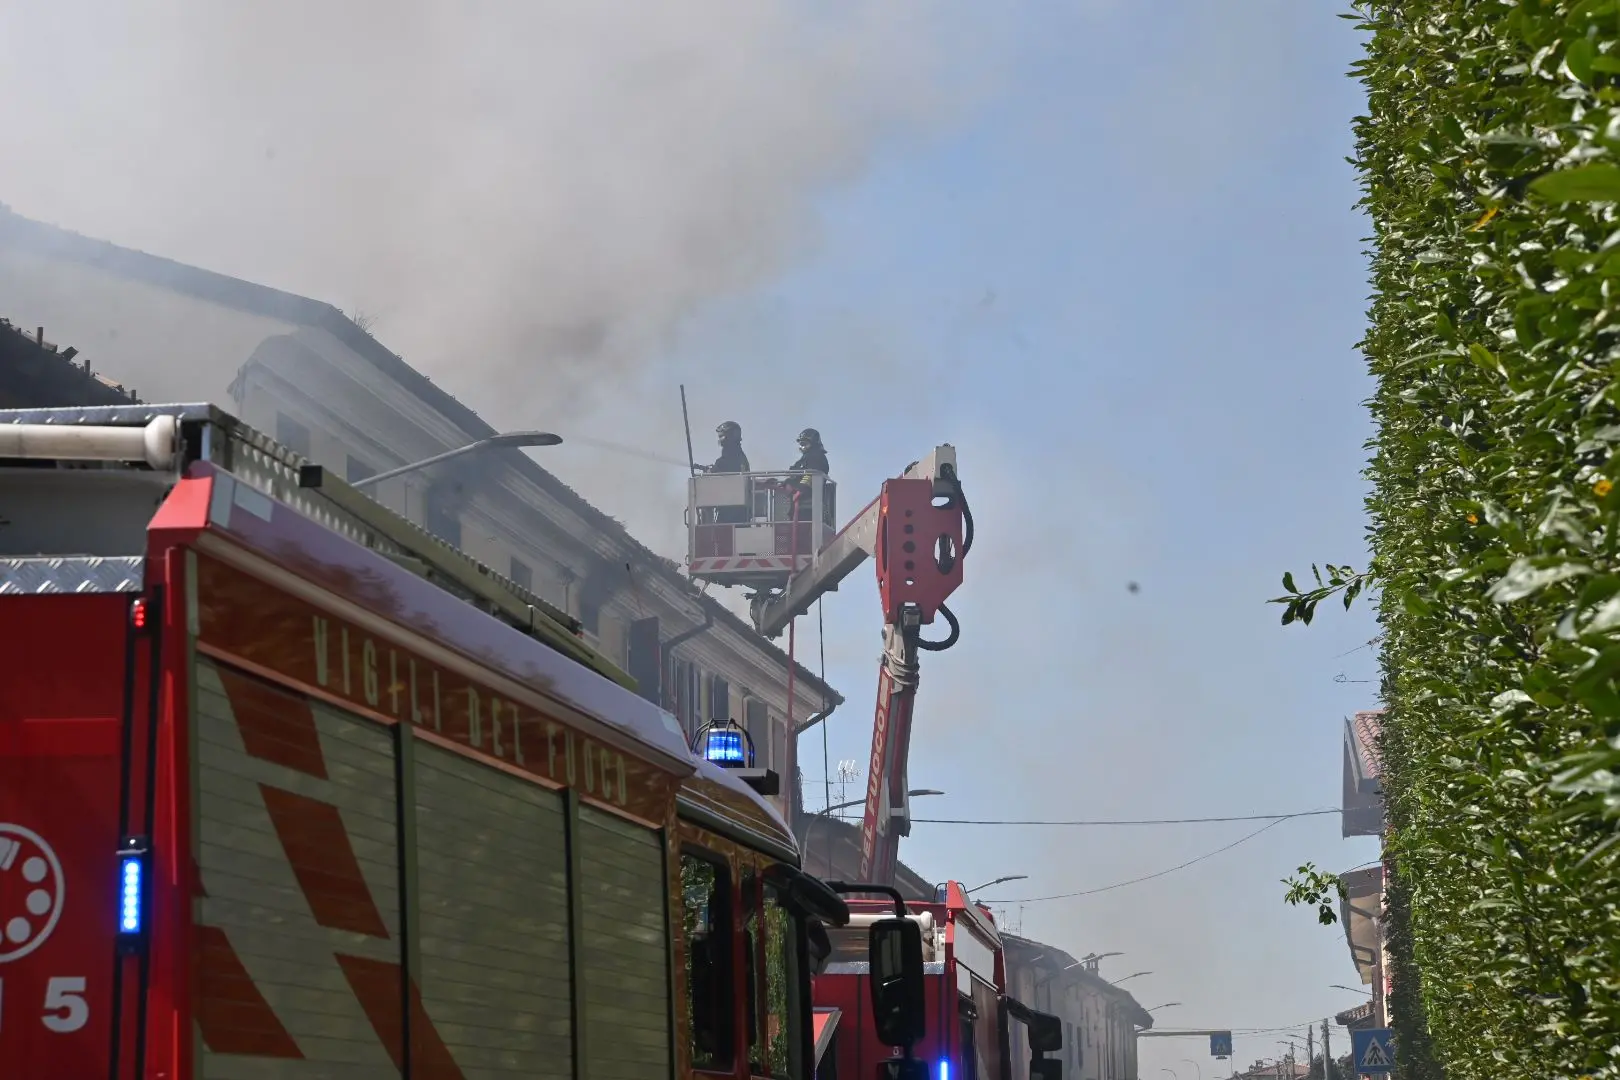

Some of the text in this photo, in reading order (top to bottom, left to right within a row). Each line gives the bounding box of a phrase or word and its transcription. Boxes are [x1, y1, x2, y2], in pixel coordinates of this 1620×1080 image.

[312, 615, 442, 733] VIGILI
[546, 724, 627, 806] FUOCO
[860, 708, 886, 881] DEL FUOCO
